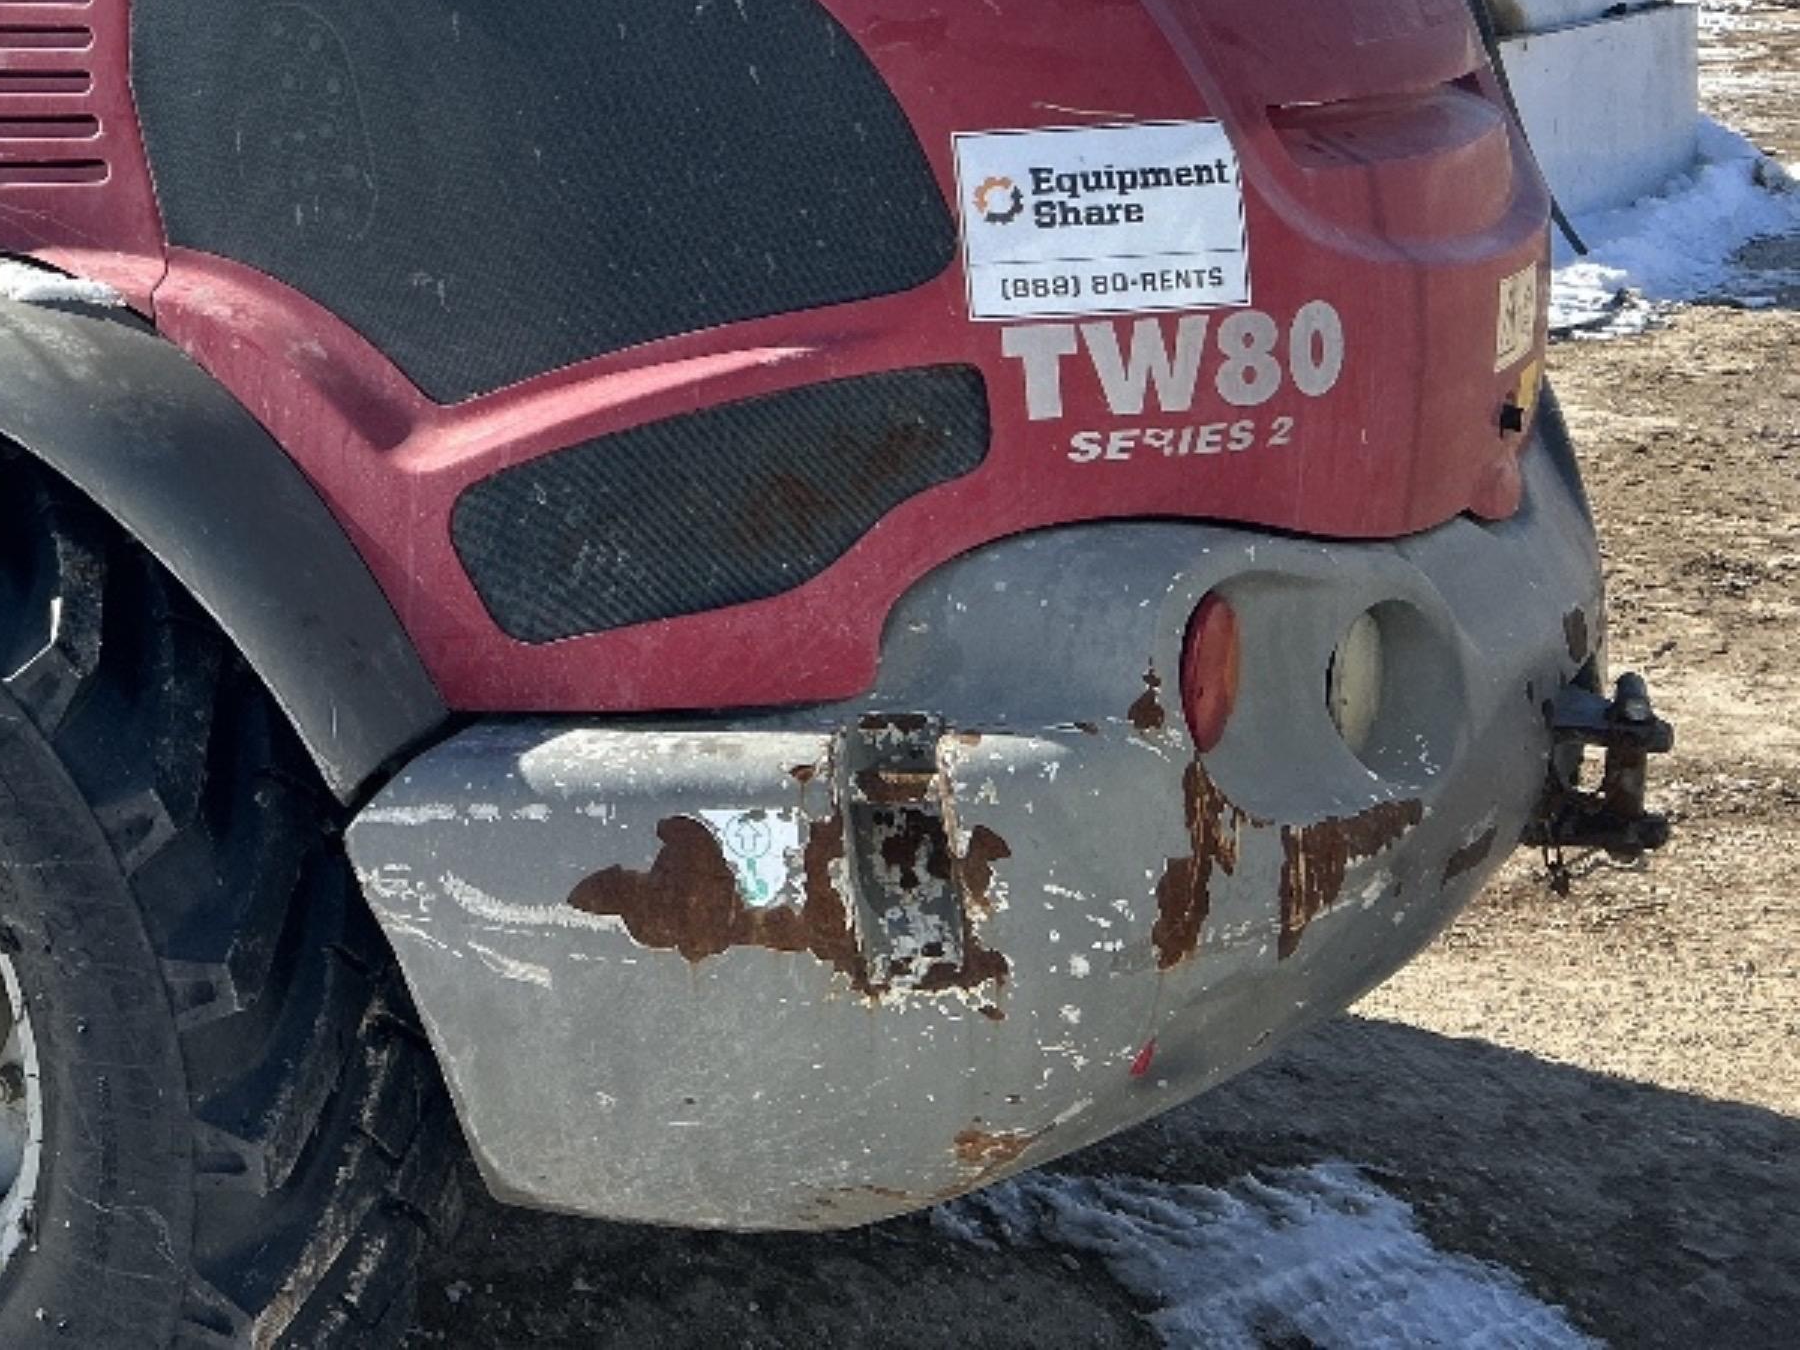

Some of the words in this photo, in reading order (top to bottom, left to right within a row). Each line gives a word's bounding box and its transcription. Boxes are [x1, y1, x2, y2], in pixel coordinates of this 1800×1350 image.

[1029, 158, 1231, 199] Equipment
[1033, 200, 1145, 229] Share
[1001, 275, 1081, 300] (888)
[1001, 299, 1345, 421] TW80
[1067, 419, 1256, 463] SERIES
[1267, 416, 1294, 448] 2
